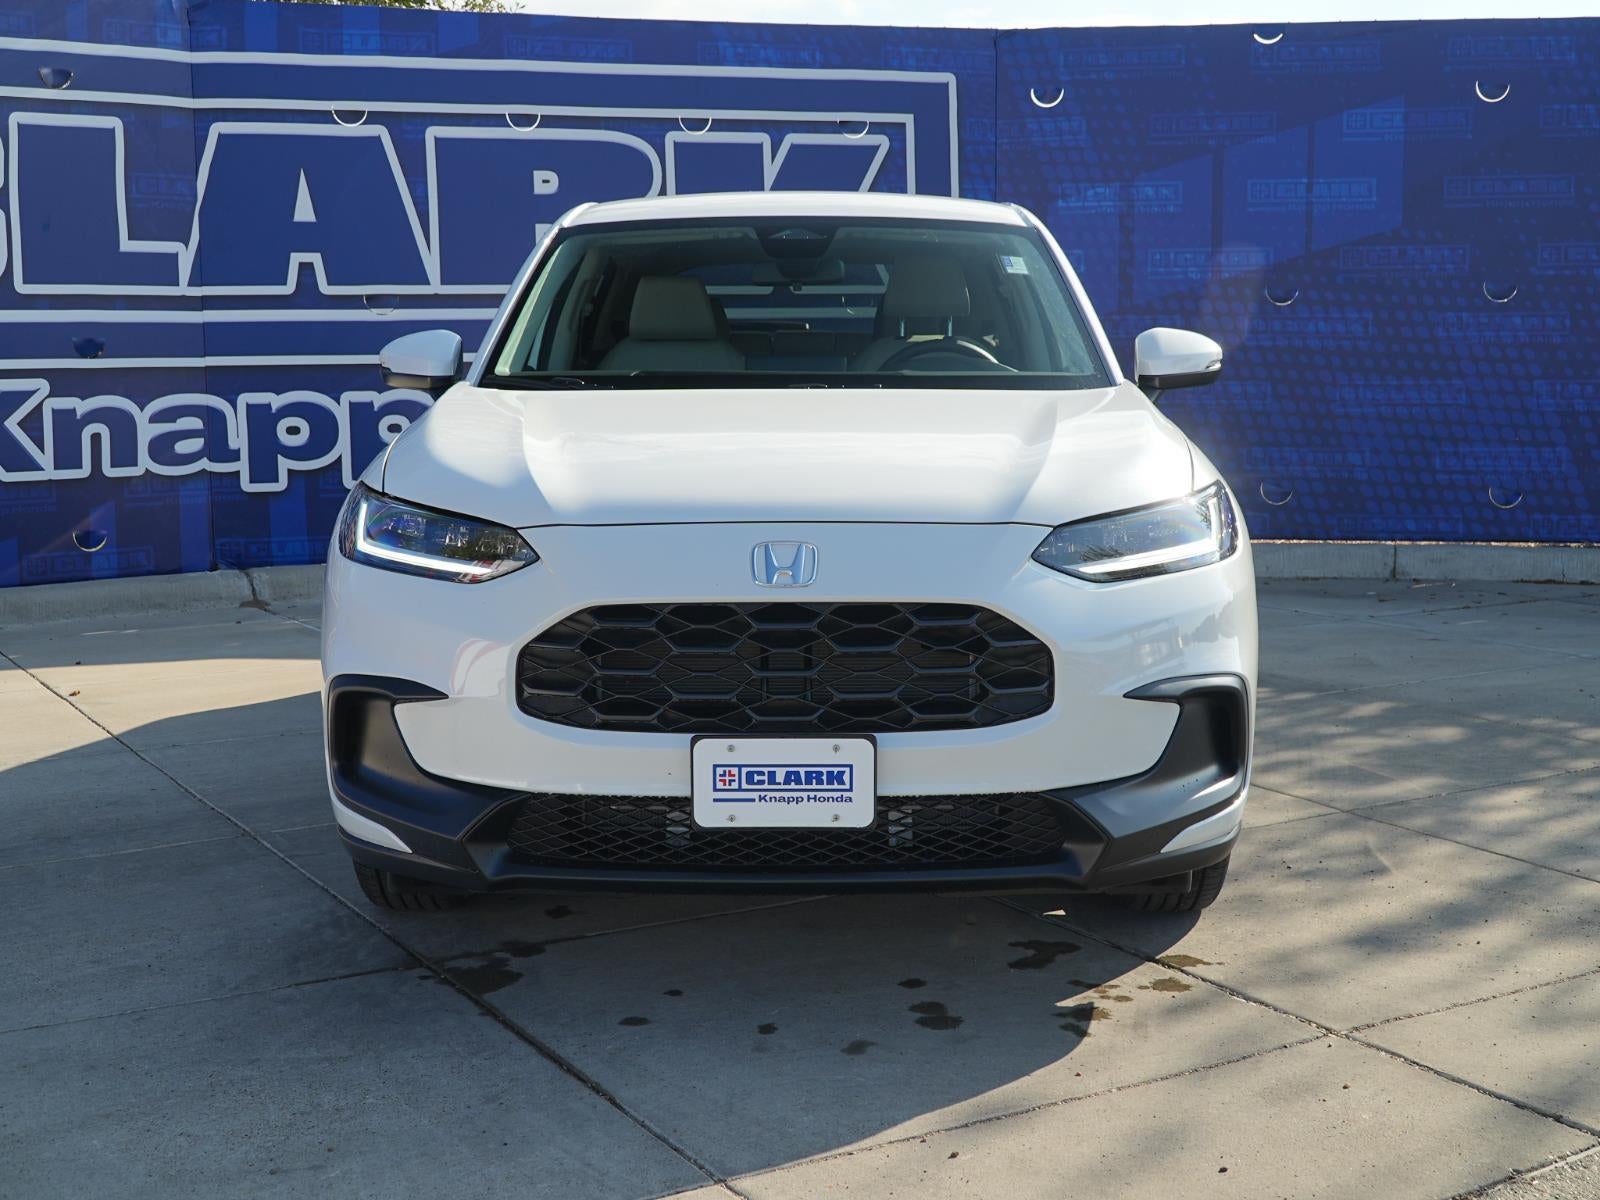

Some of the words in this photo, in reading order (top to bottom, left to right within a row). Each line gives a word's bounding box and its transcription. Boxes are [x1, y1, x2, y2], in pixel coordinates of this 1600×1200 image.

[0, 111, 889, 296] LAR
[745, 770, 847, 786] CLARK
[758, 794, 804, 804] Knapp
[806, 794, 853, 803] Honda
